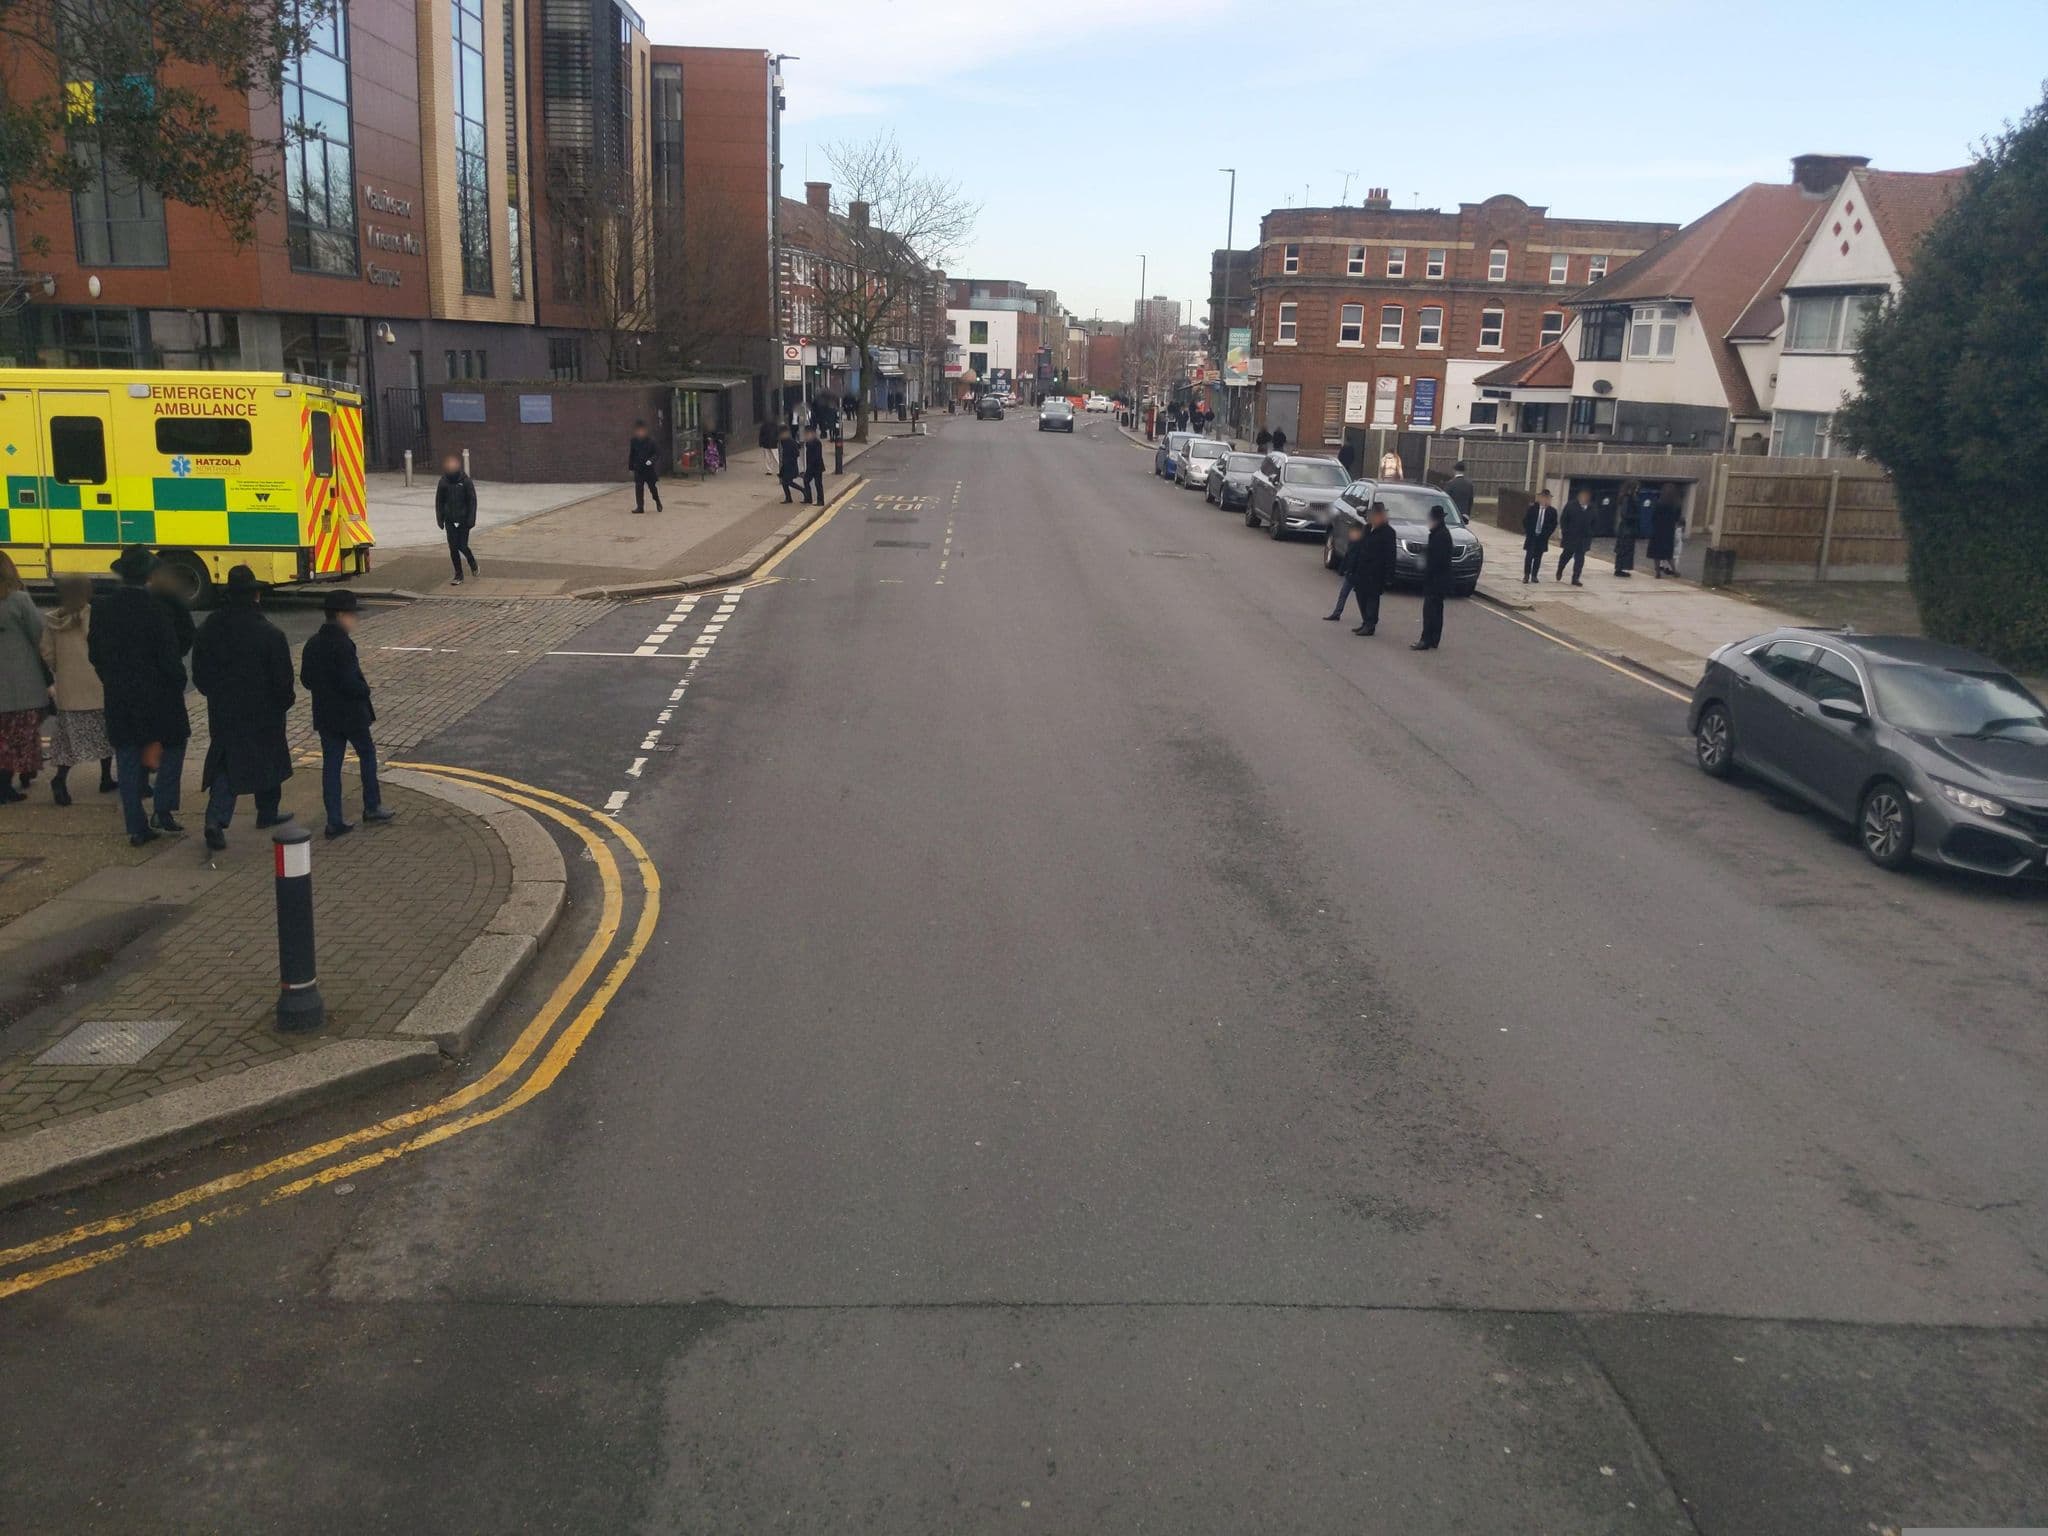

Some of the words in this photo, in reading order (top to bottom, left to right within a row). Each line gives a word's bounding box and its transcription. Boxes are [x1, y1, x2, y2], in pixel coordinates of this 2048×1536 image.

[152, 386, 257, 400] EMERGENCY
[153, 403, 258, 416] AMBULANCE
[195, 458, 241, 466] HATZOLA
[873, 494, 940, 504] BUS
